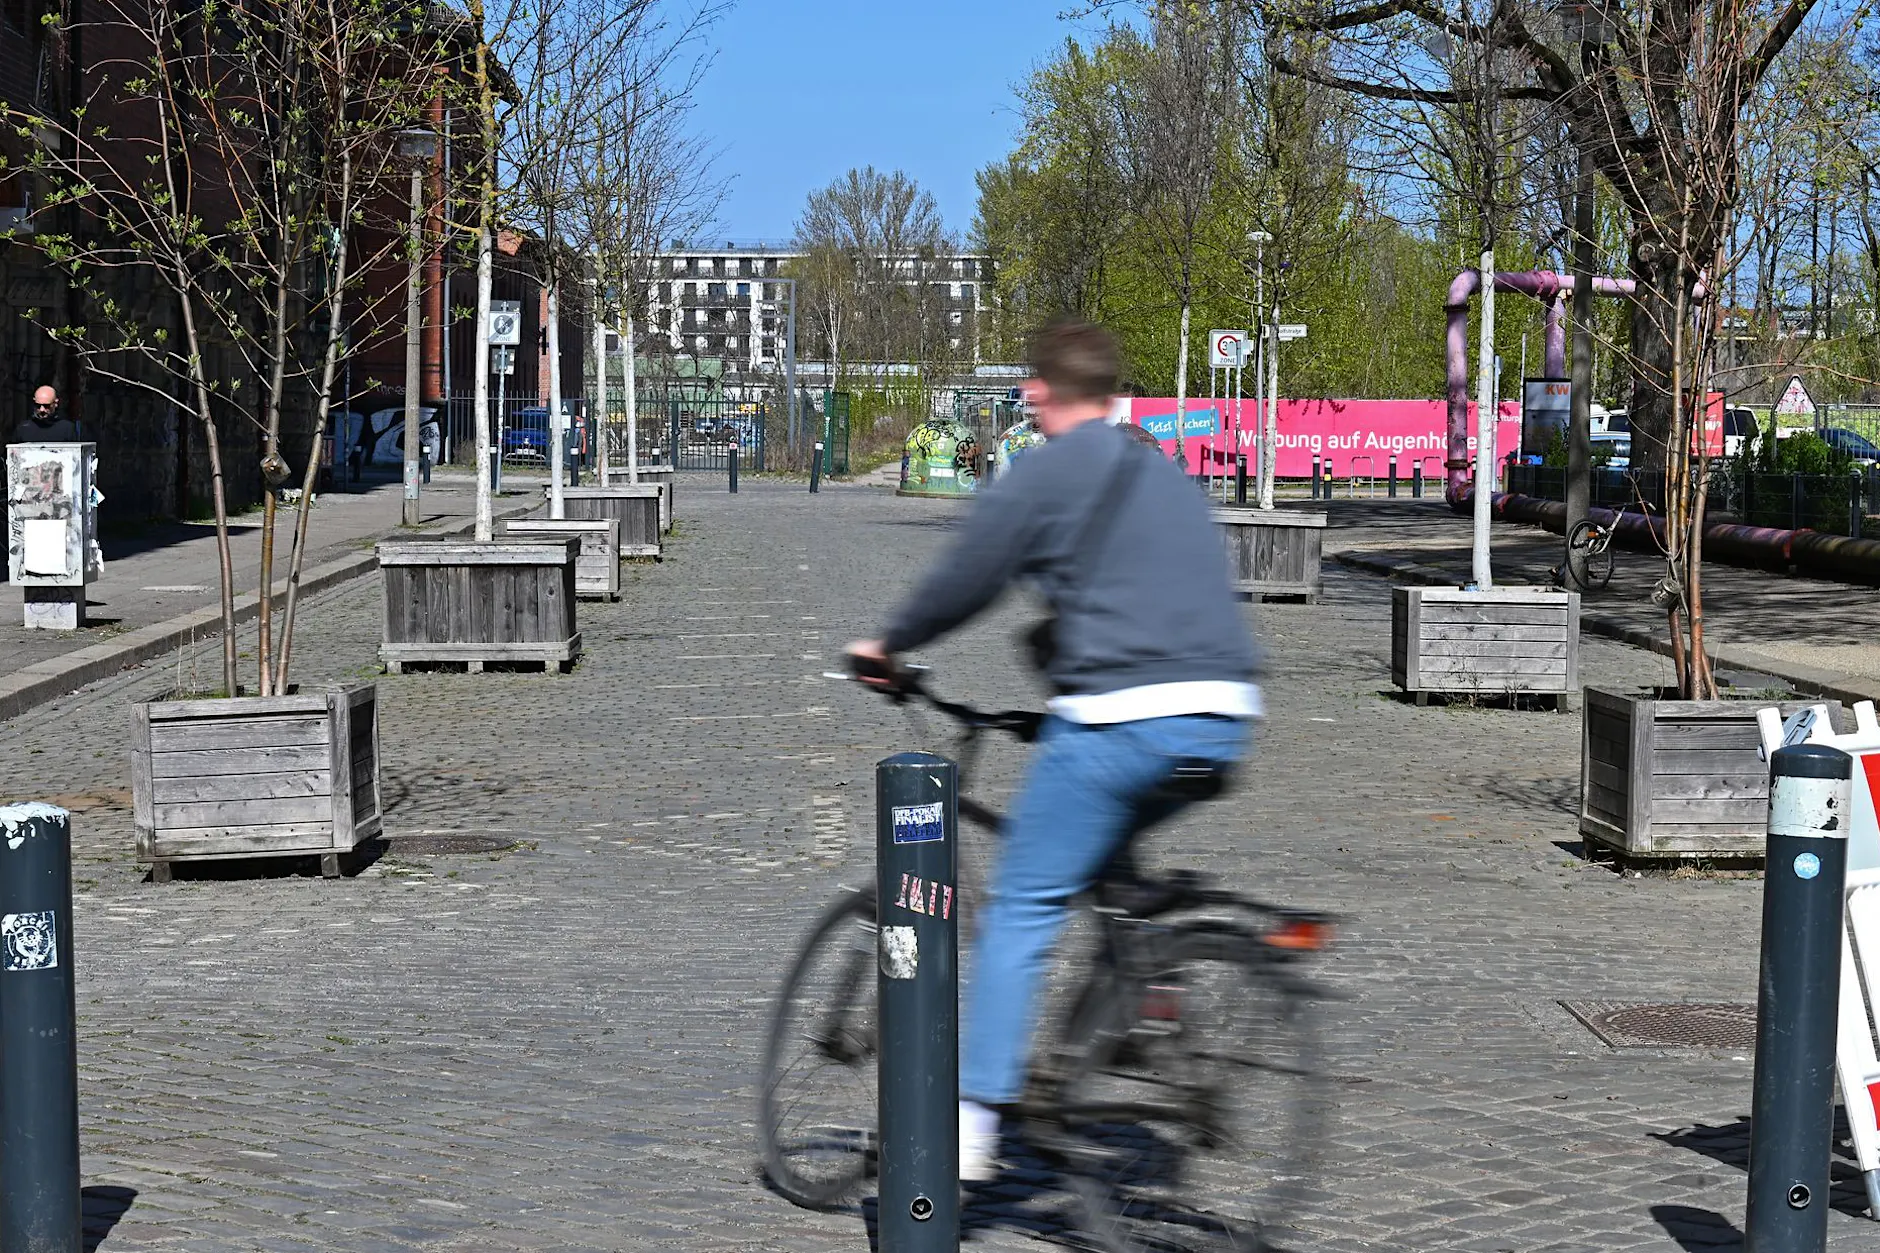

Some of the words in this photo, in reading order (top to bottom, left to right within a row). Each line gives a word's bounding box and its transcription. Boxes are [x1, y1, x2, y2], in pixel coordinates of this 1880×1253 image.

[1147, 419, 1174, 434] Jetzt
[1233, 429, 1322, 453] Wbung
[1327, 430, 1361, 449] auf
[1364, 431, 1478, 454] Augenhöe
[895, 813, 941, 826] FINALIST
